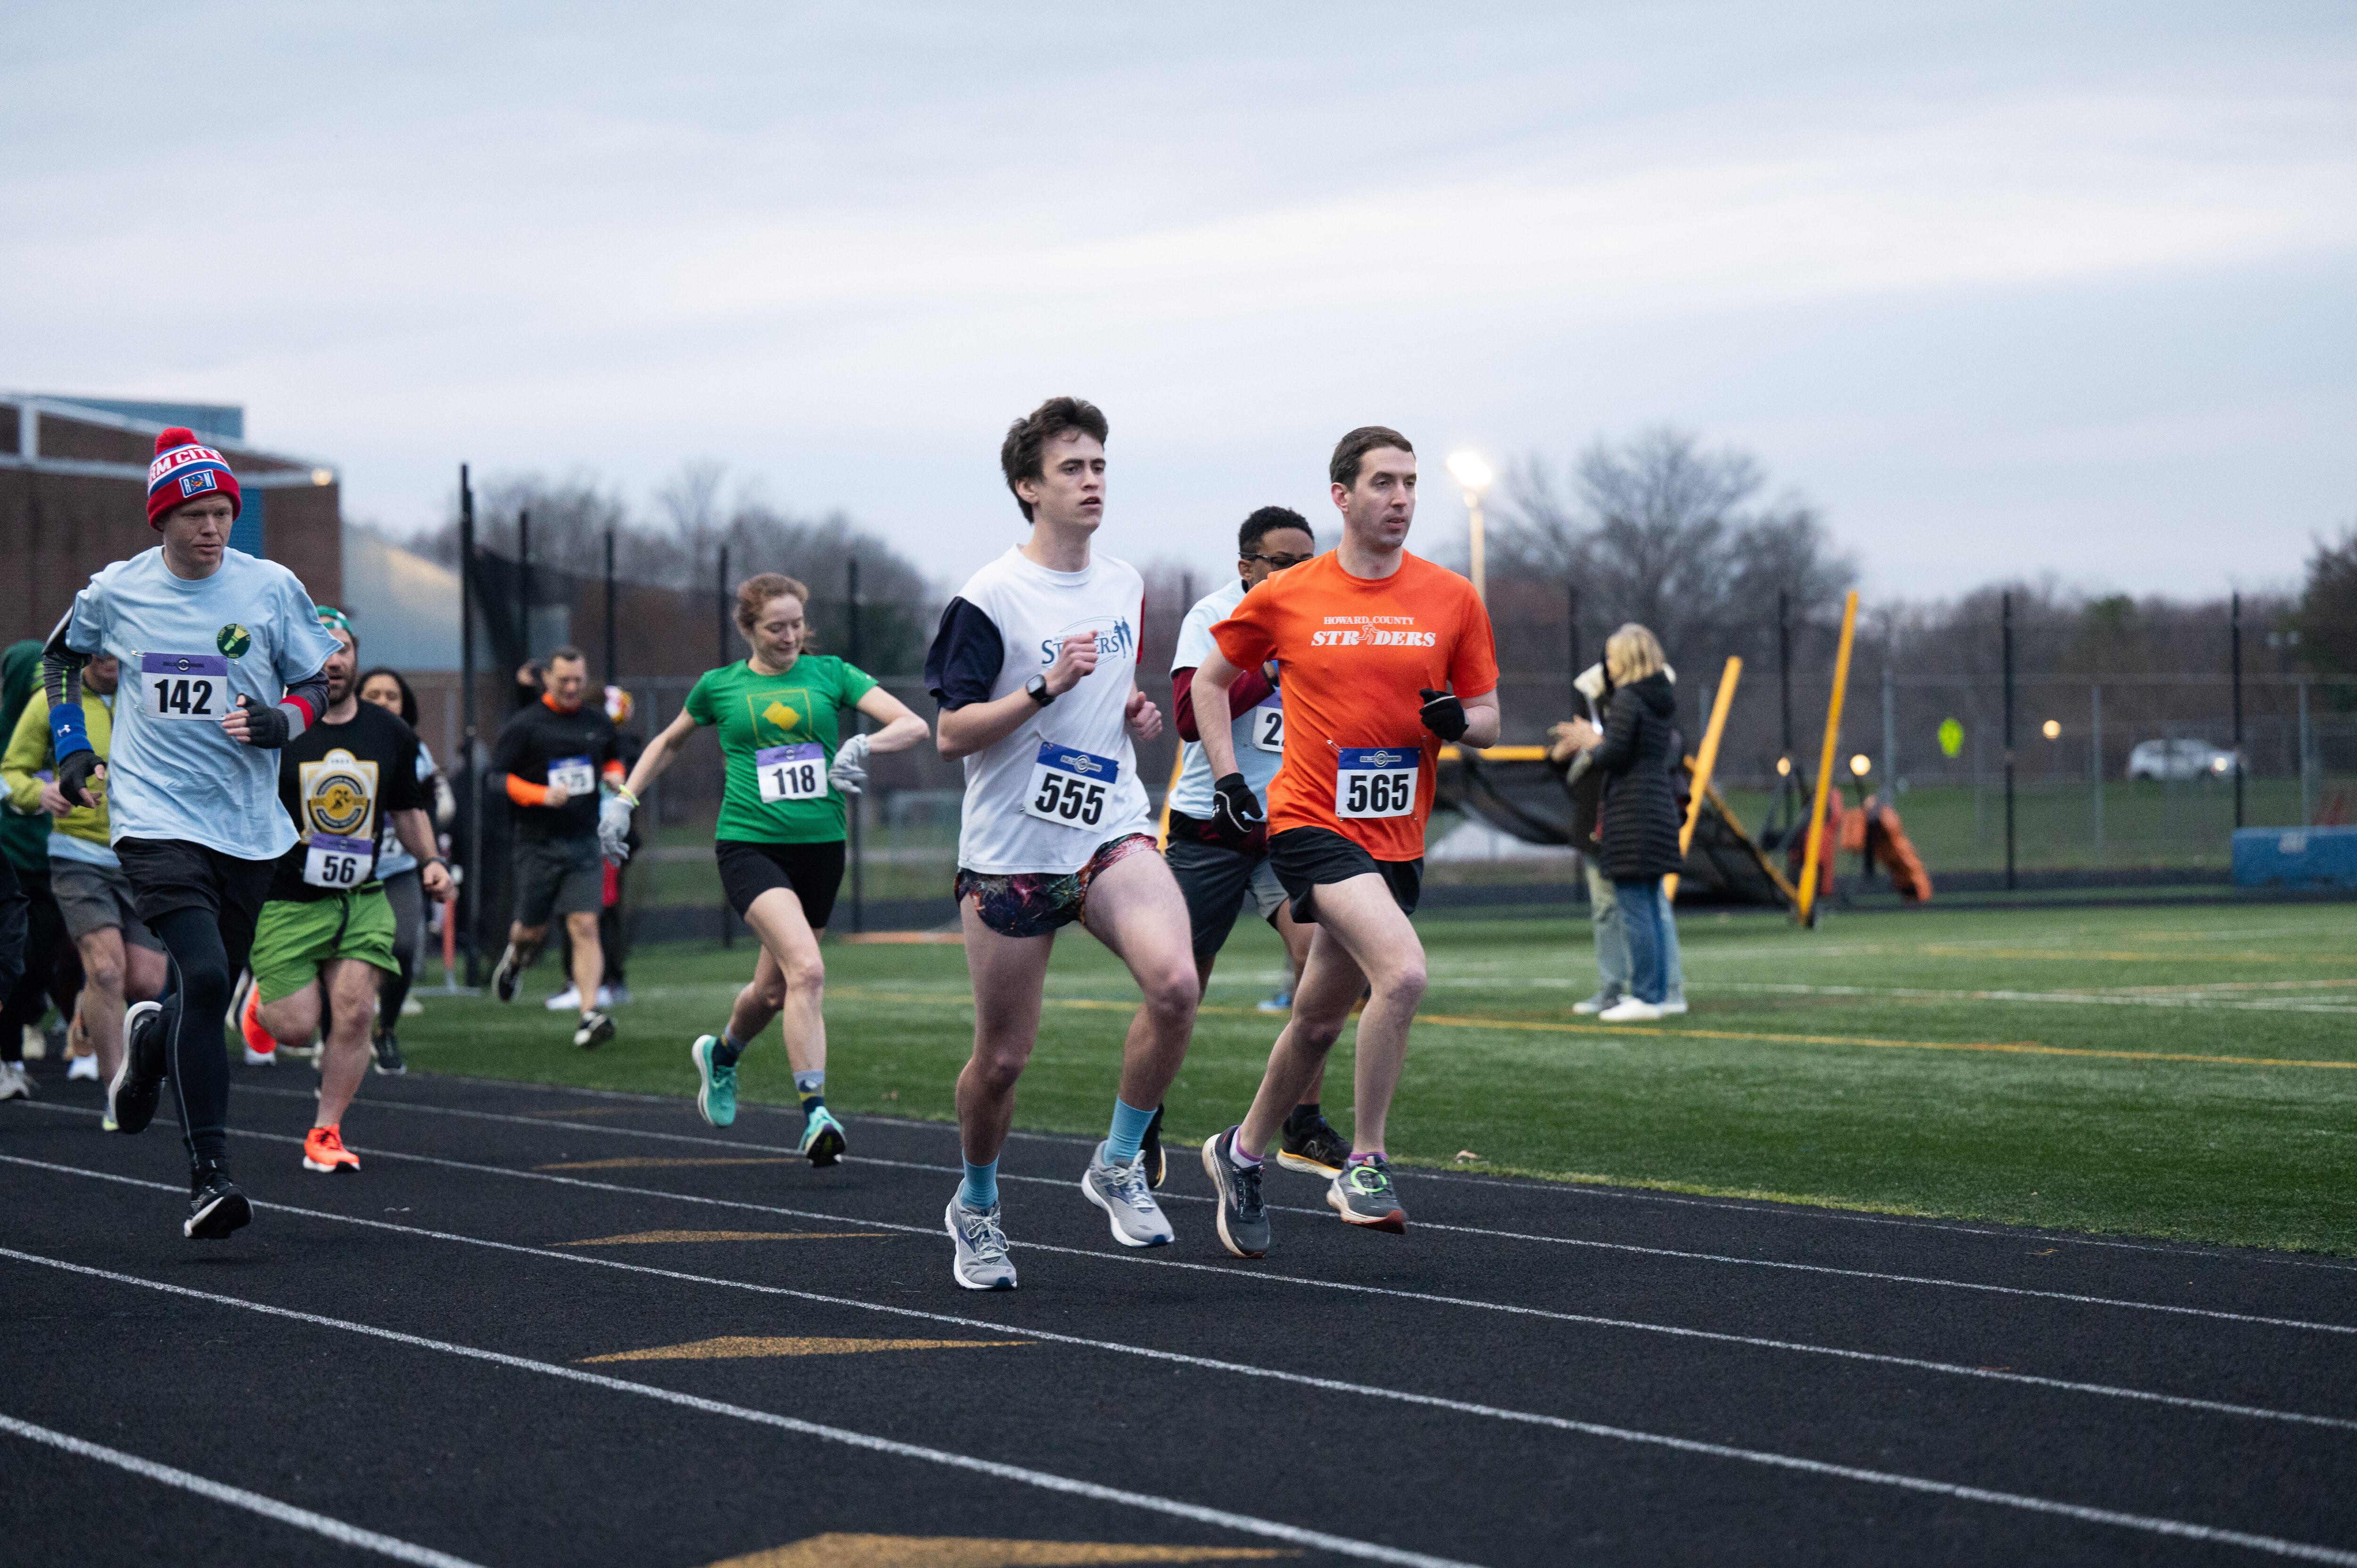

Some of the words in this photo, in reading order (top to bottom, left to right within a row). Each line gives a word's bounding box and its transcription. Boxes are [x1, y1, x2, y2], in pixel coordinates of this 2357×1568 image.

[175, 448, 221, 464] CITY
[183, 473, 212, 493] RN
[1324, 616, 1368, 624] HOWARD
[1372, 616, 1415, 625] COUNTY
[1041, 636, 1120, 664] STERS
[1310, 631, 1436, 647] STRDERS
[154, 679, 212, 714] 142
[1263, 712, 1285, 747] 2
[772, 764, 816, 795] 118
[1347, 774, 1409, 812] 565
[1035, 772, 1106, 825] 555
[322, 855, 356, 884] 56
